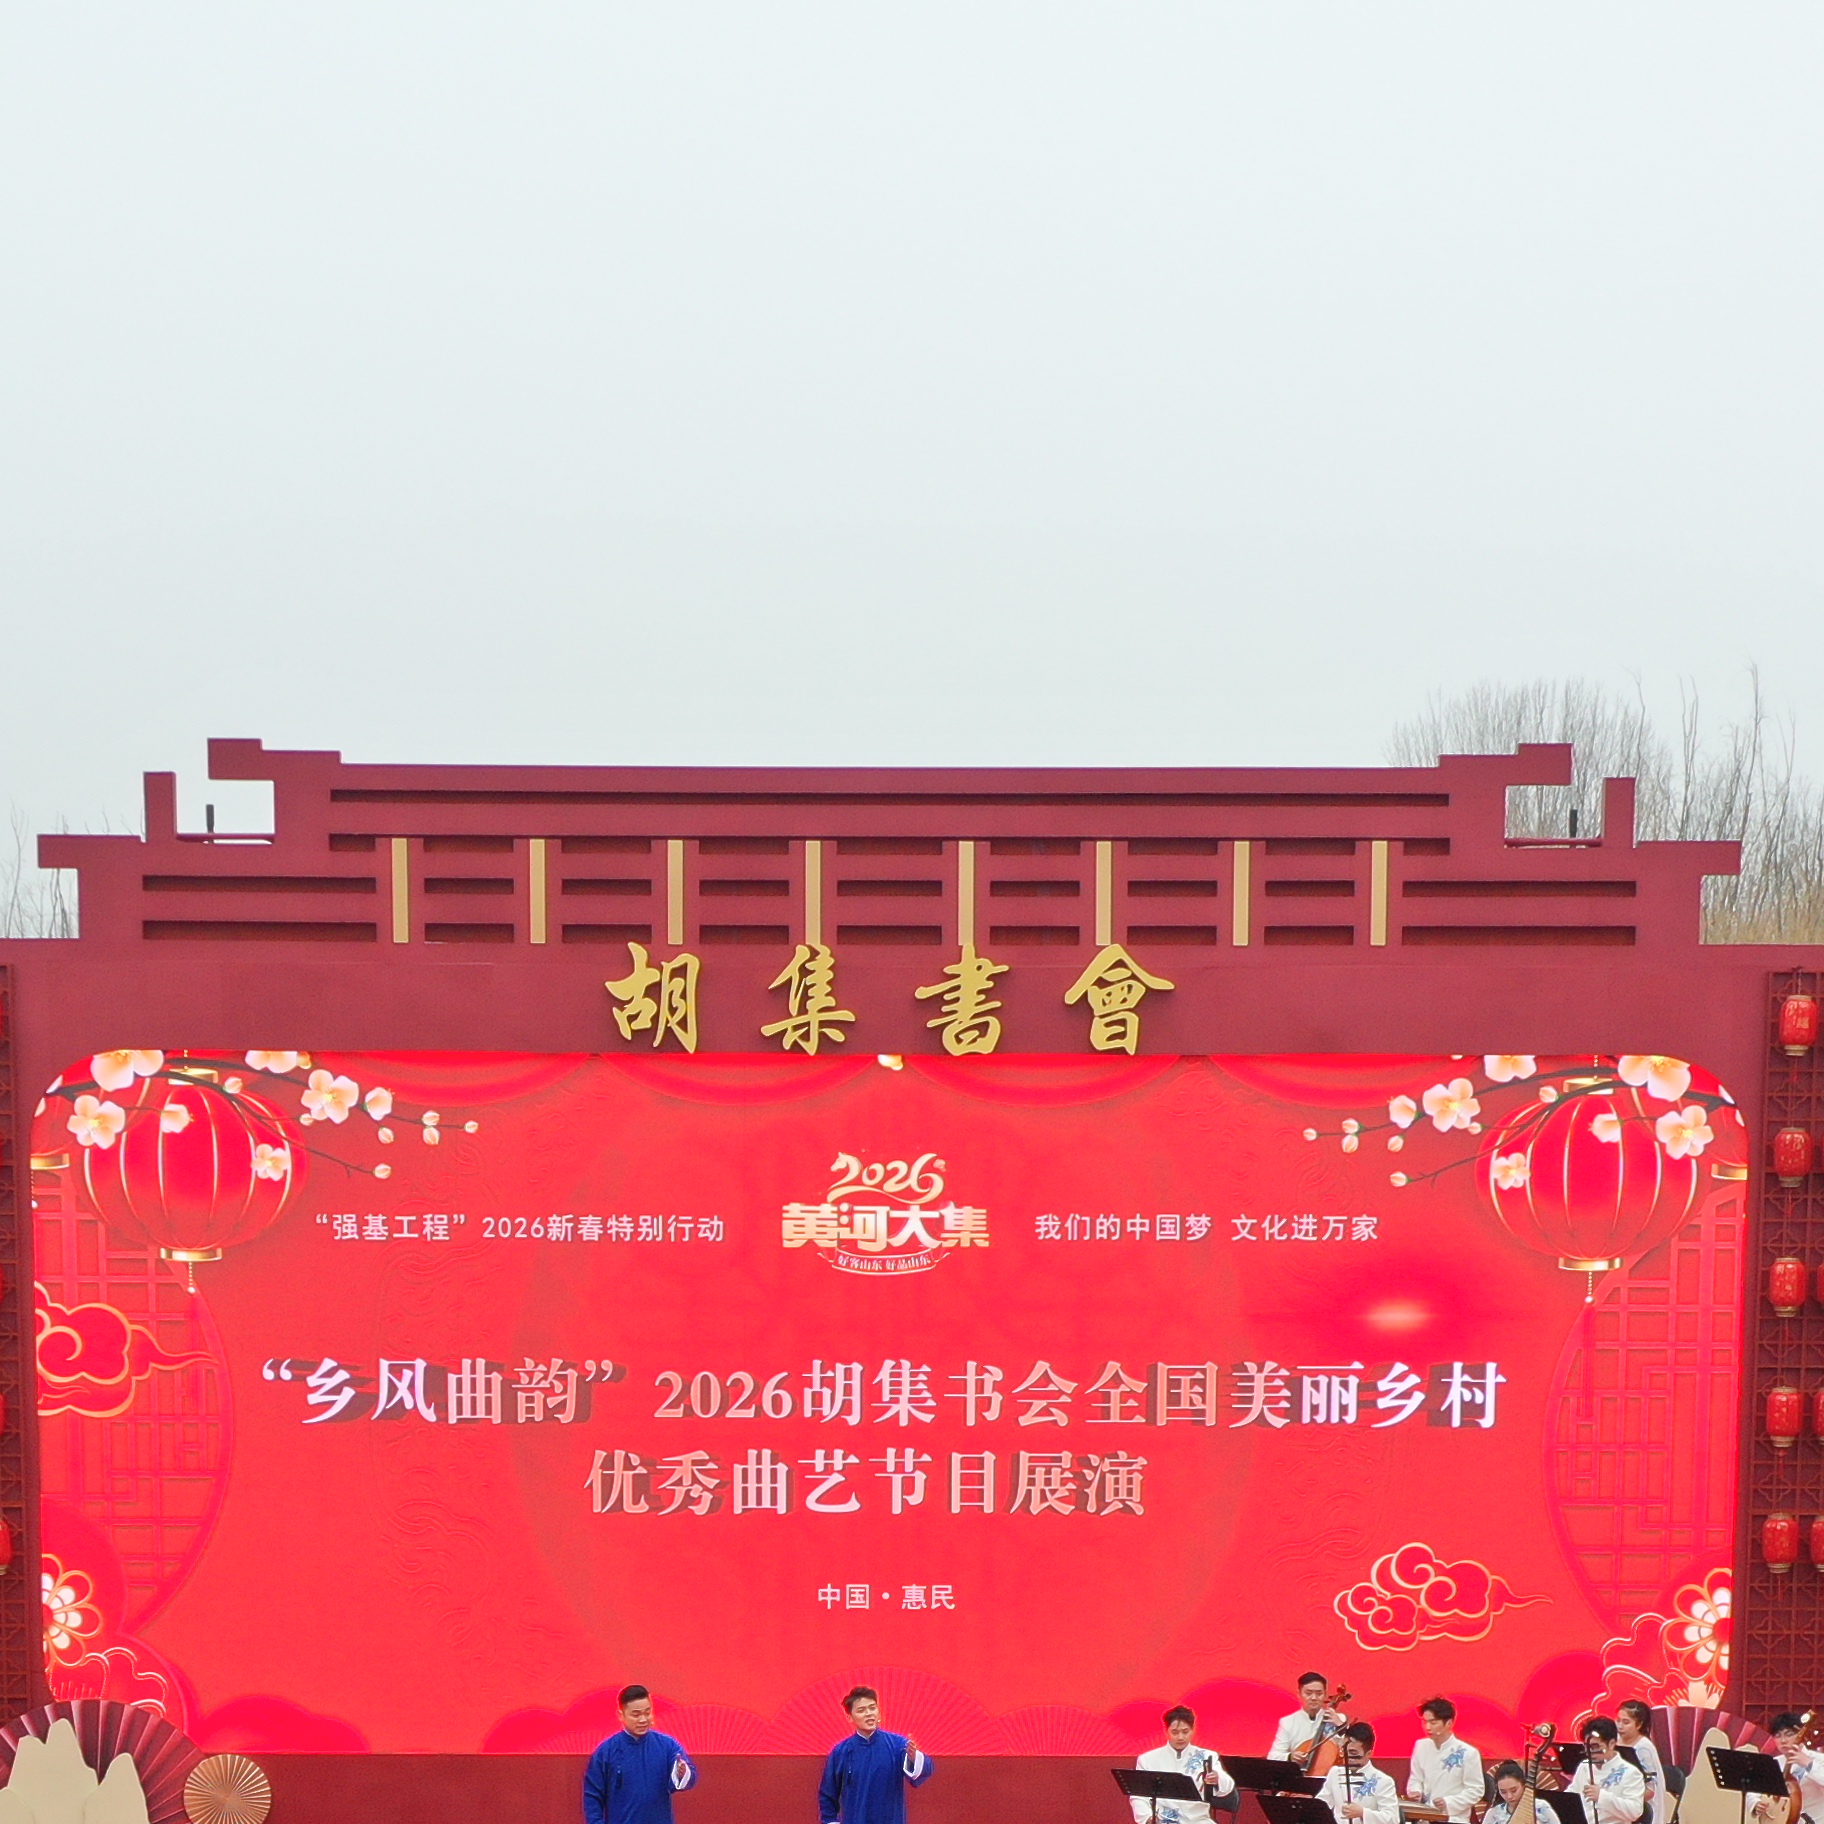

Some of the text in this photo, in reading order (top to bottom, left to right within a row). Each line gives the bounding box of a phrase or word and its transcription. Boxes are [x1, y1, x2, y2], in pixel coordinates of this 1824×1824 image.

[605, 942, 1174, 1056] 胡集書會
[827, 1152, 946, 1204] 2026
[482, 1213, 725, 1242] 2026新春特别行动
[782, 1201, 989, 1251] 黄河大集
[1035, 1213, 1378, 1242] 我们的中国梦 文化进万家
[654, 1358, 1506, 1428] 2026胡集书会全国美丽乡村
[584, 1447, 1147, 1517] 优秀曲艺节目展演
